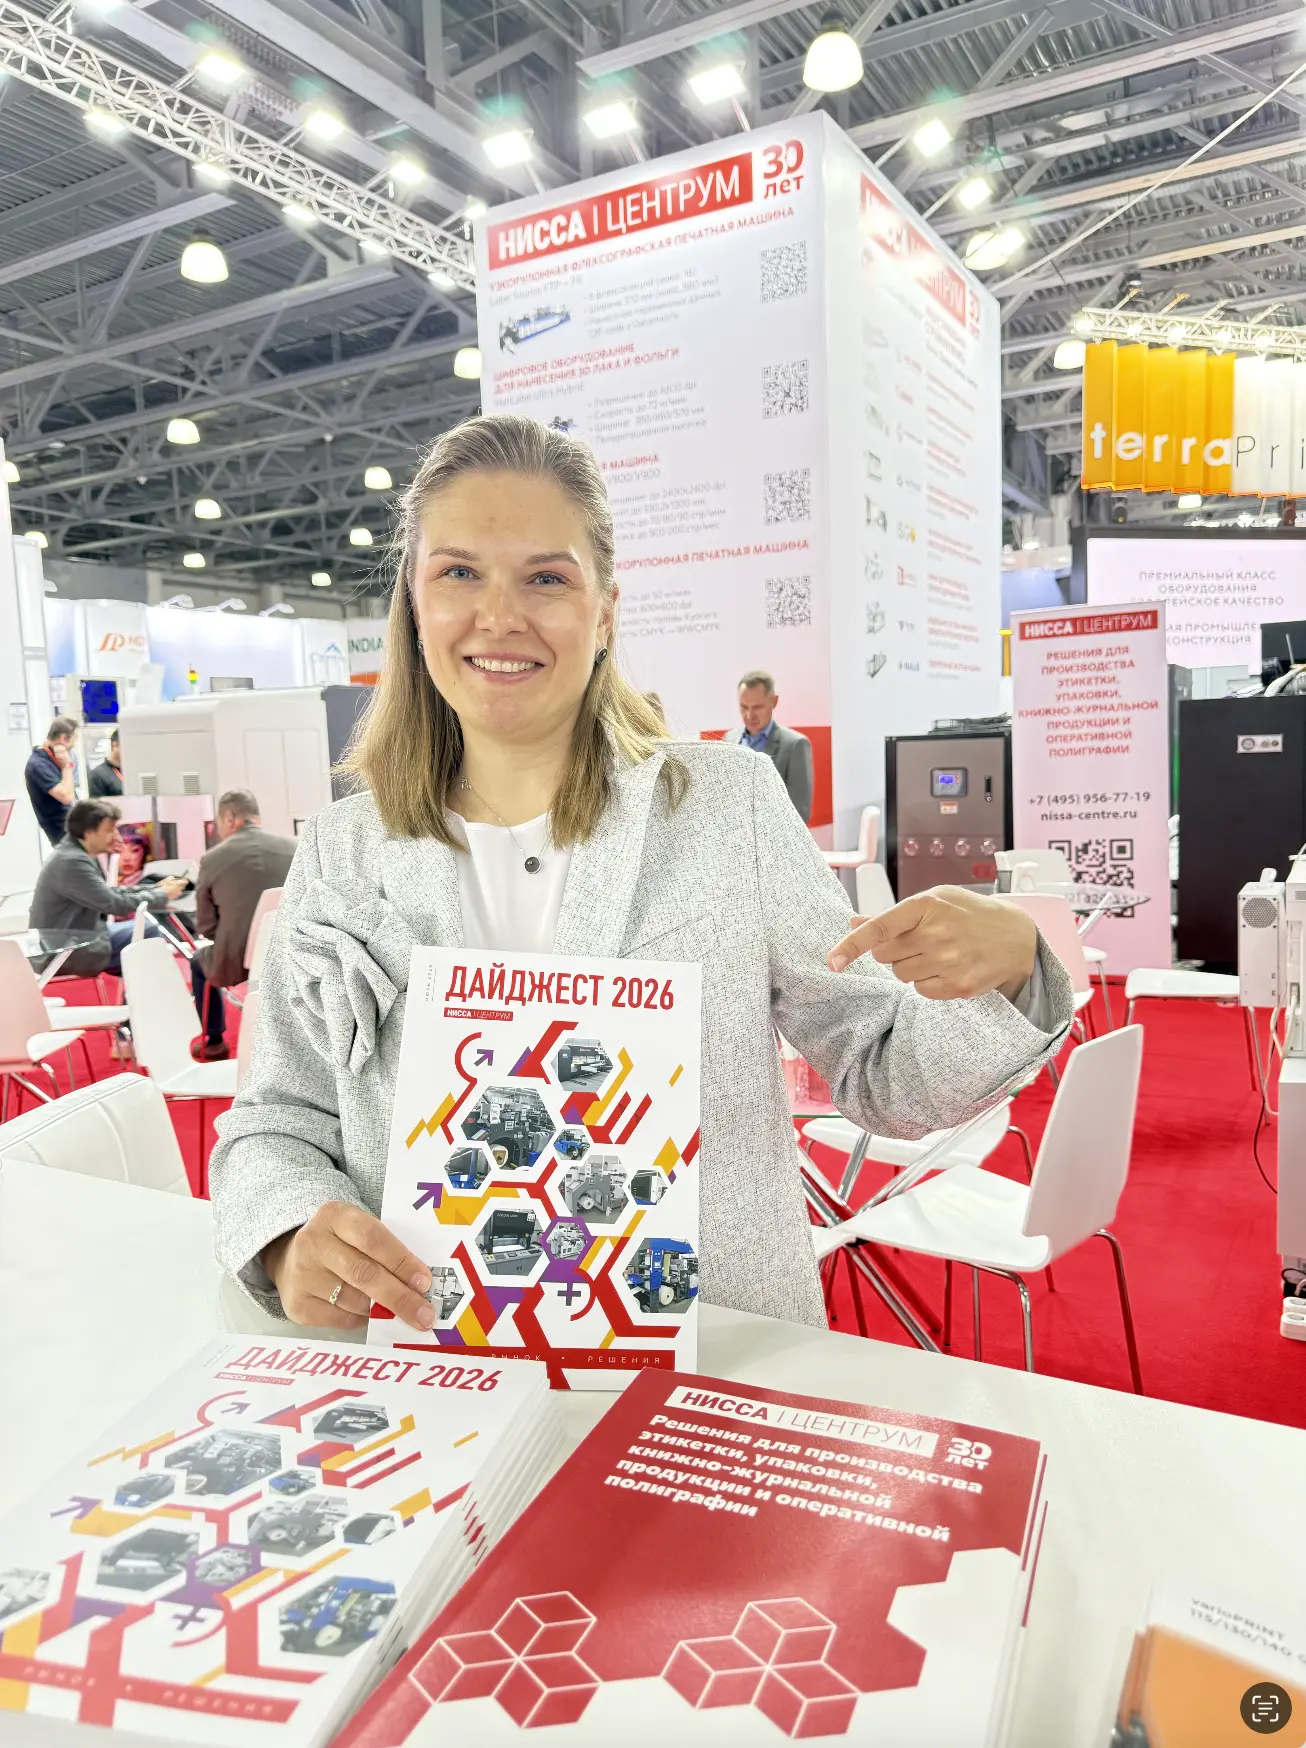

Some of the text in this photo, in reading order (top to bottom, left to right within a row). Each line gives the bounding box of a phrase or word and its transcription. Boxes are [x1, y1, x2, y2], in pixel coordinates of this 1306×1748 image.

[763, 139, 804, 180] 30
[764, 174, 804, 200] лет
[499, 165, 740, 260] НИССА ЦЕНТРУМ
[674, 221, 734, 245] ПЕЧАТНАЯ
[736, 206, 794, 230] МАШИНА
[551, 342, 634, 369] ОБОРУДОВАНИЕ
[634, 347, 678, 366] ФОЛЬГИ
[609, 453, 659, 469] МАШИНА
[692, 545, 749, 563] ПЕЧАТНАЯ
[752, 538, 808, 556] МАШИНА
[1139, 569, 1276, 580] ПРЕМИАЛЬНЫЙ КЛАСС
[1158, 584, 1257, 594] ОБОРУДОВАНИЯ
[1223, 596, 1284, 606] КАЧЕСТВО
[1025, 622, 1073, 637] НИССА
[1083, 614, 1152, 633] ЦЕНТРУМ
[1047, 646, 1129, 661] РЕШЕНИЯ ДЛЯ
[1041, 660, 1135, 676] ПРОИЗВОДСТВА
[1018, 700, 1159, 718] КНИЖНО-ЖУРНАЛЬНОЙ
[1047, 717, 1131, 730] ПРОДУКЦИИ И
[1046, 730, 1132, 744] ОПЕРАТИВНОЙ
[1049, 744, 1130, 757] ПОЛИГРАФИИ
[1029, 791, 1151, 806] +7 (495) 956-77-19
[1041, 809, 1137, 821] nissa-centre.ru
[445, 962, 674, 1010] ДАЙДЖЕСТ 2026
[447, 1009, 511, 1020] НИССА ЦЕНТРУМ
[224, 1346, 420, 1383] ДАЙДЖЕСТ
[418, 1364, 503, 1392] 2026
[587, 1355, 660, 1364] РЕШЕНИЯ
[218, 1372, 292, 1386] НИССА ЦЕНТРУМ
[681, 1390, 925, 1450] НИССА ЦЕНТРУМ
[649, 1414, 984, 1495] Решения для производства
[950, 1436, 992, 1460] 30
[638, 1430, 880, 1491] этикетки, упаковки,
[946, 1453, 990, 1471] лет
[627, 1443, 892, 1510] книжно-журнальной
[604, 1474, 759, 1517] полиграфии
[616, 1457, 951, 1542] продукции и оперативной
[1191, 1597, 1286, 1641] varioPRINT
[1190, 1606, 1292, 1657] 115/130/140
